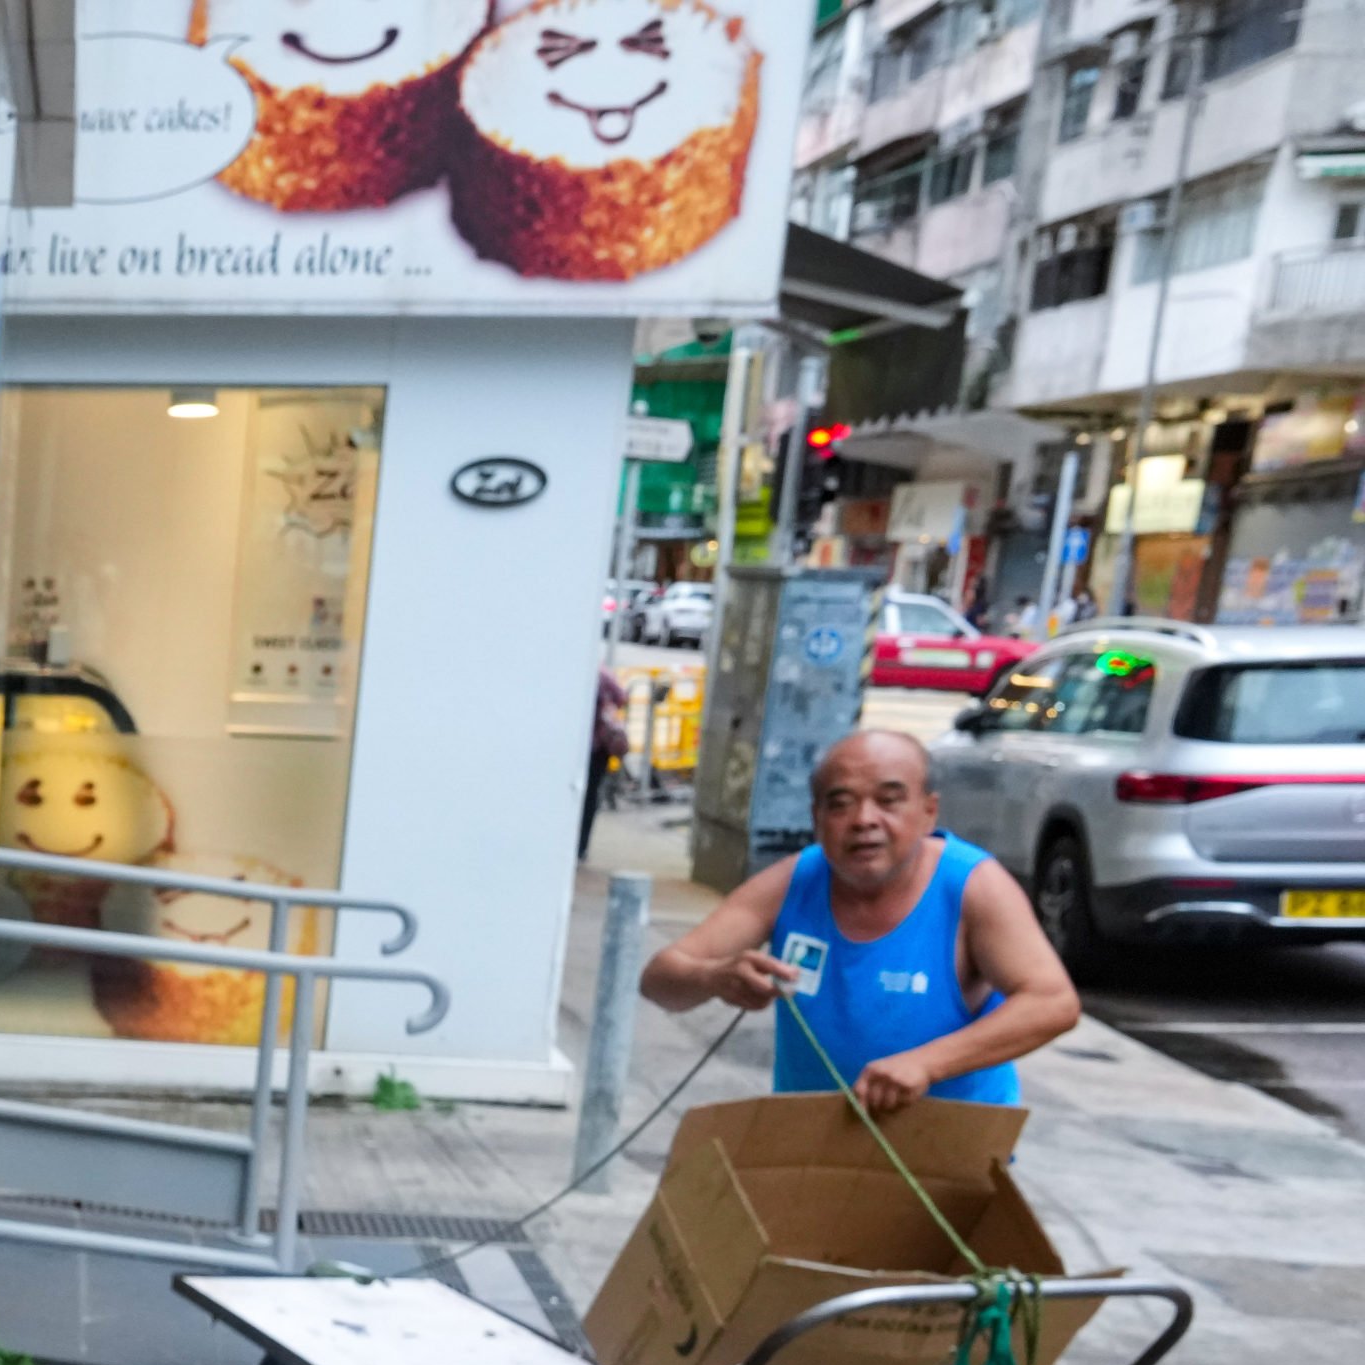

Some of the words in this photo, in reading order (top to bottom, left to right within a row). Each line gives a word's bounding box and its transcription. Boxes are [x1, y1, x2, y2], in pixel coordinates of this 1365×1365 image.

[49, 232, 110, 277] live
[118, 246, 164, 277] on
[176, 231, 280, 277] bread
[293, 231, 394, 277] alone
